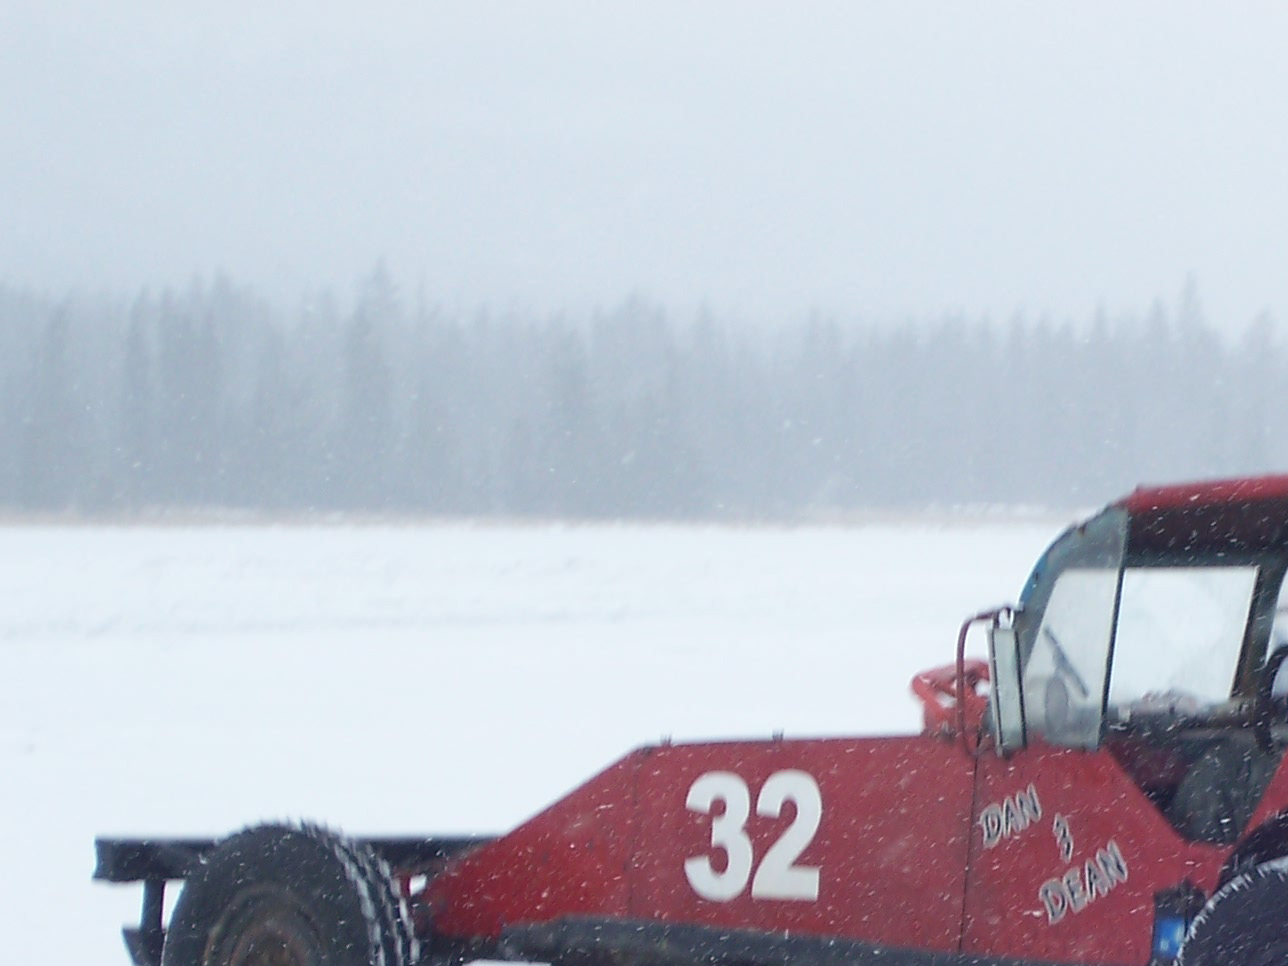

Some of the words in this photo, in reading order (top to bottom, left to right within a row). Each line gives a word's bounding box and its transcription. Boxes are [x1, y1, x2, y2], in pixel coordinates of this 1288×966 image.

[684, 769, 822, 902] 32
[980, 782, 1042, 849] DAN
[1038, 838, 1129, 925] DEAN
